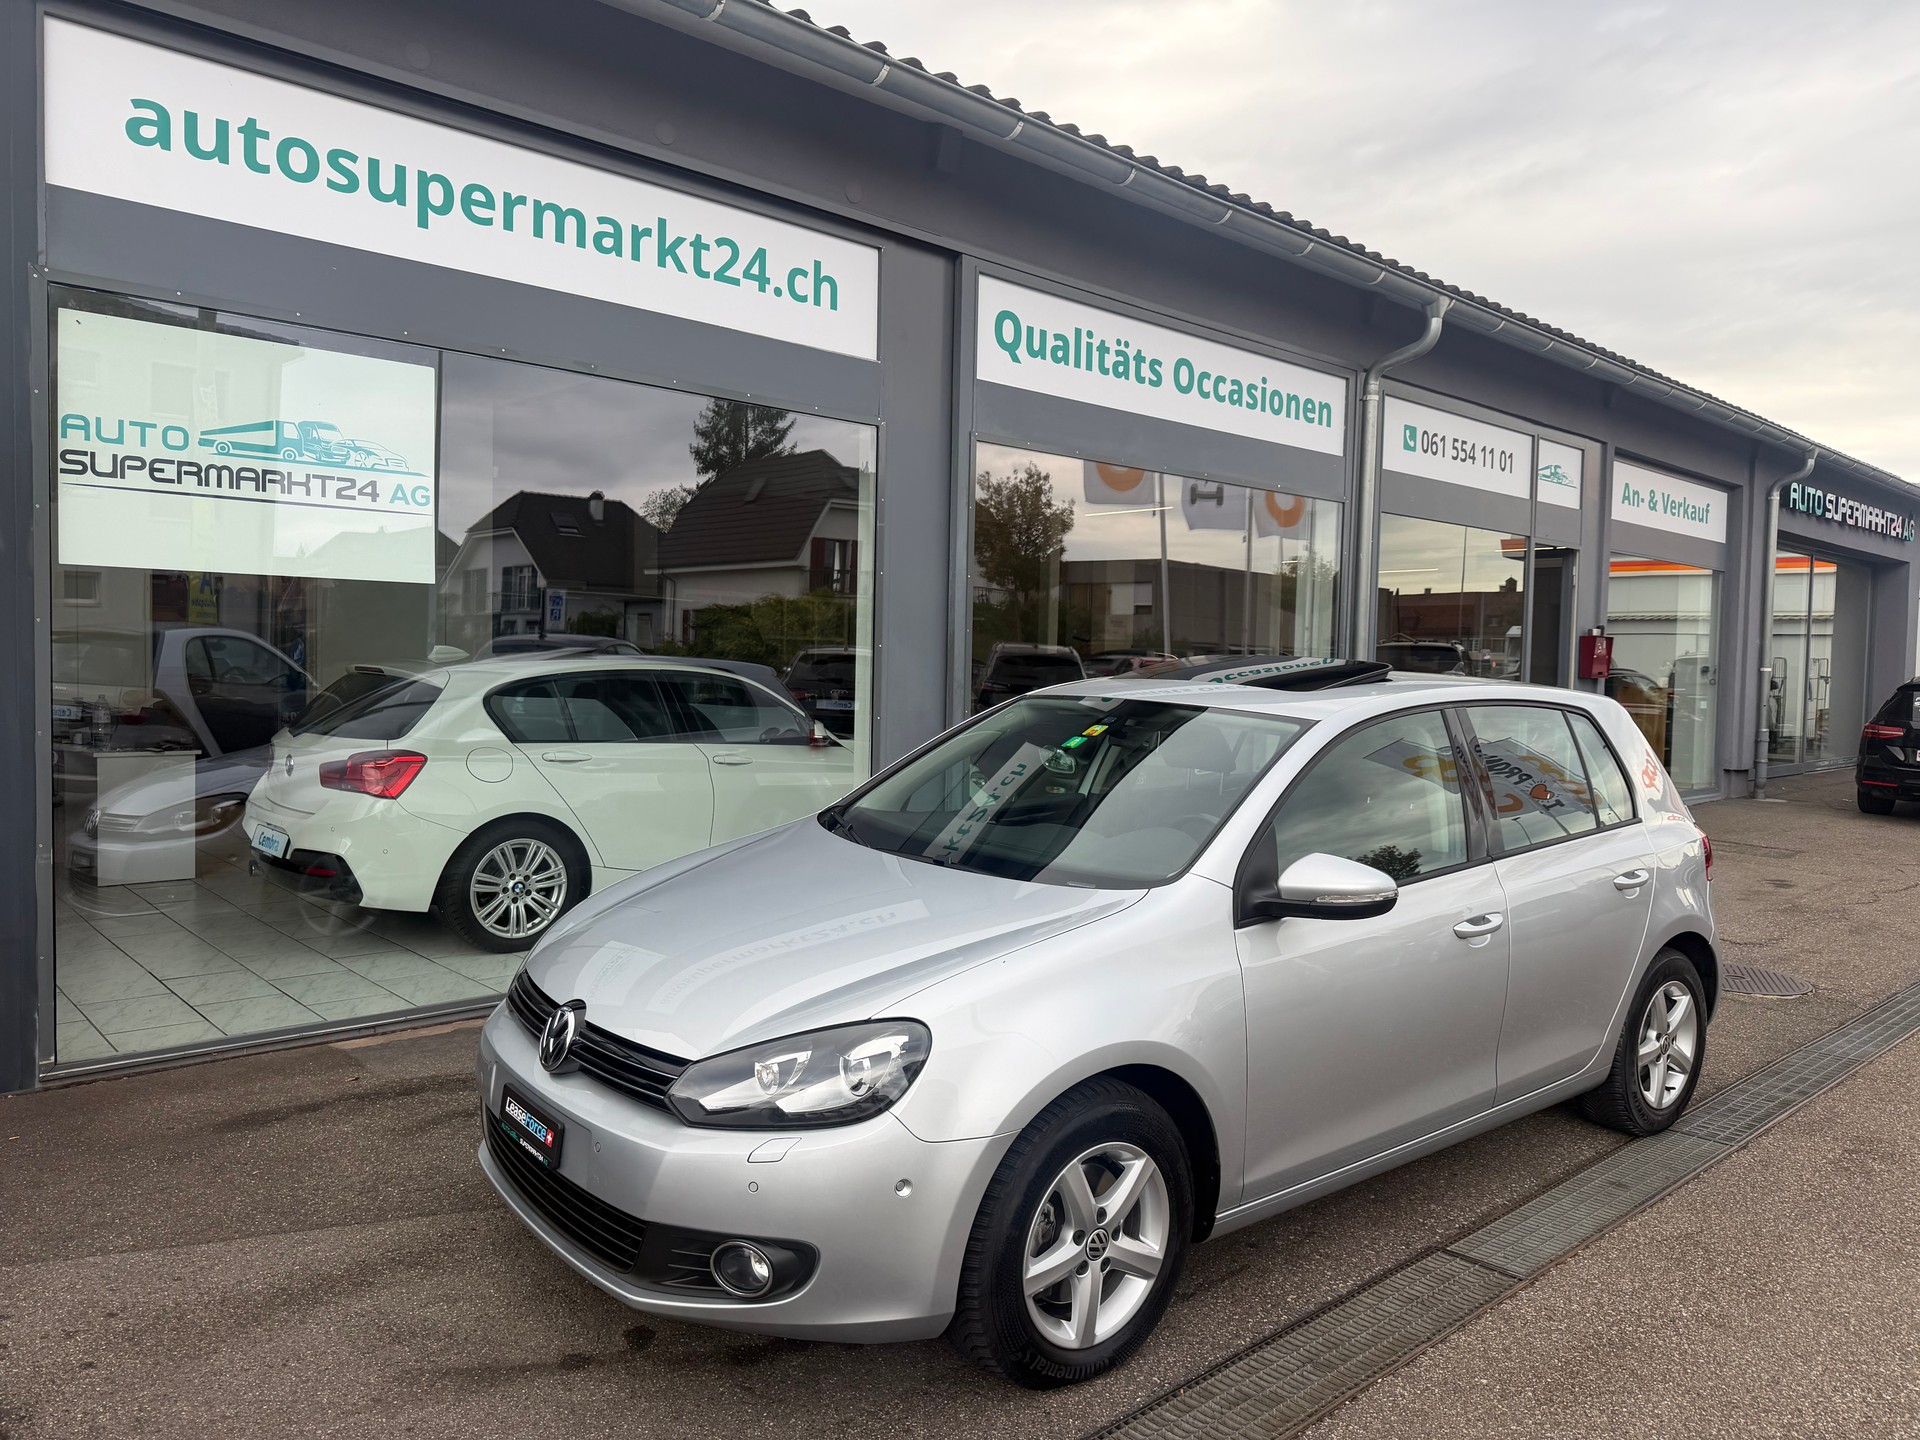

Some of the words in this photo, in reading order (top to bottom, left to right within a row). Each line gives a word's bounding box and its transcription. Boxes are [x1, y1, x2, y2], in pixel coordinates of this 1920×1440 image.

[125, 98, 839, 312] autosupermarkt24.ch
[994, 309, 1164, 389] Qualitäts
[1173, 357, 1333, 428] Occasionen
[59, 412, 191, 453] AUTO
[1421, 430, 1446, 458] 061
[1451, 437, 1477, 465] 554
[1480, 445, 1495, 470] 11
[1499, 449, 1514, 474] 01
[59, 448, 380, 503] SUPERMARKT24
[389, 483, 432, 508] AG
[1621, 482, 1645, 508] An-
[1648, 488, 1659, 513] &
[1661, 492, 1711, 525] Verkauf
[1789, 482, 1824, 516] AUTO
[1825, 493, 1903, 539] SUPERMARKT24
[1902, 518, 1915, 541] AG
[258, 831, 280, 852] Cembra
[505, 1097, 547, 1141] LeaseForce
